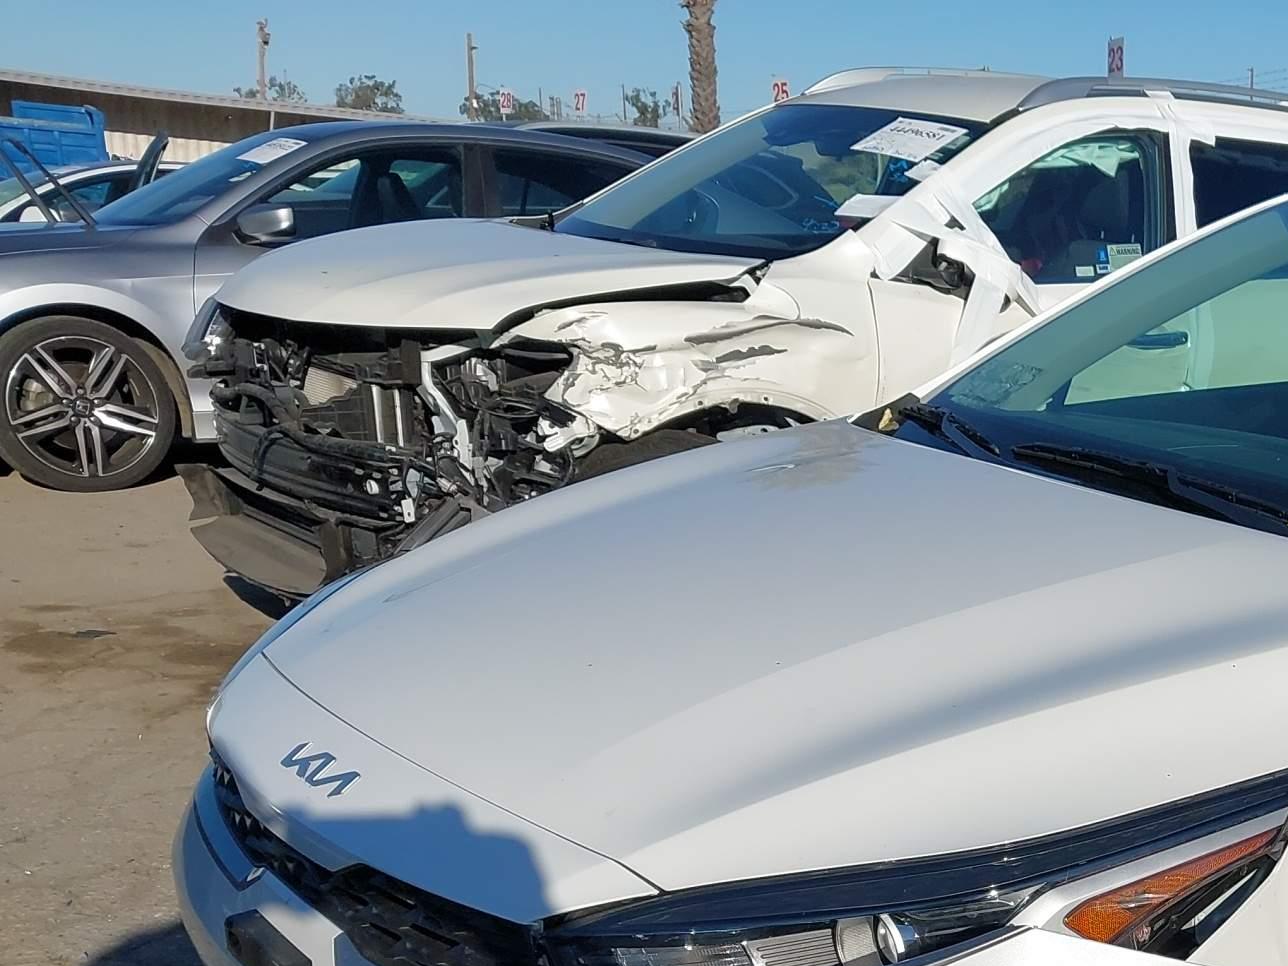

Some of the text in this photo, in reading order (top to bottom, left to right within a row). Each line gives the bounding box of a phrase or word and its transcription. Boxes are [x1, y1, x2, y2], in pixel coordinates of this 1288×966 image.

[1108, 46, 1124, 73] 23
[500, 92, 512, 109] 28
[574, 92, 586, 112] 27
[772, 82, 789, 102] 25
[1115, 247, 1140, 255] WARNING
